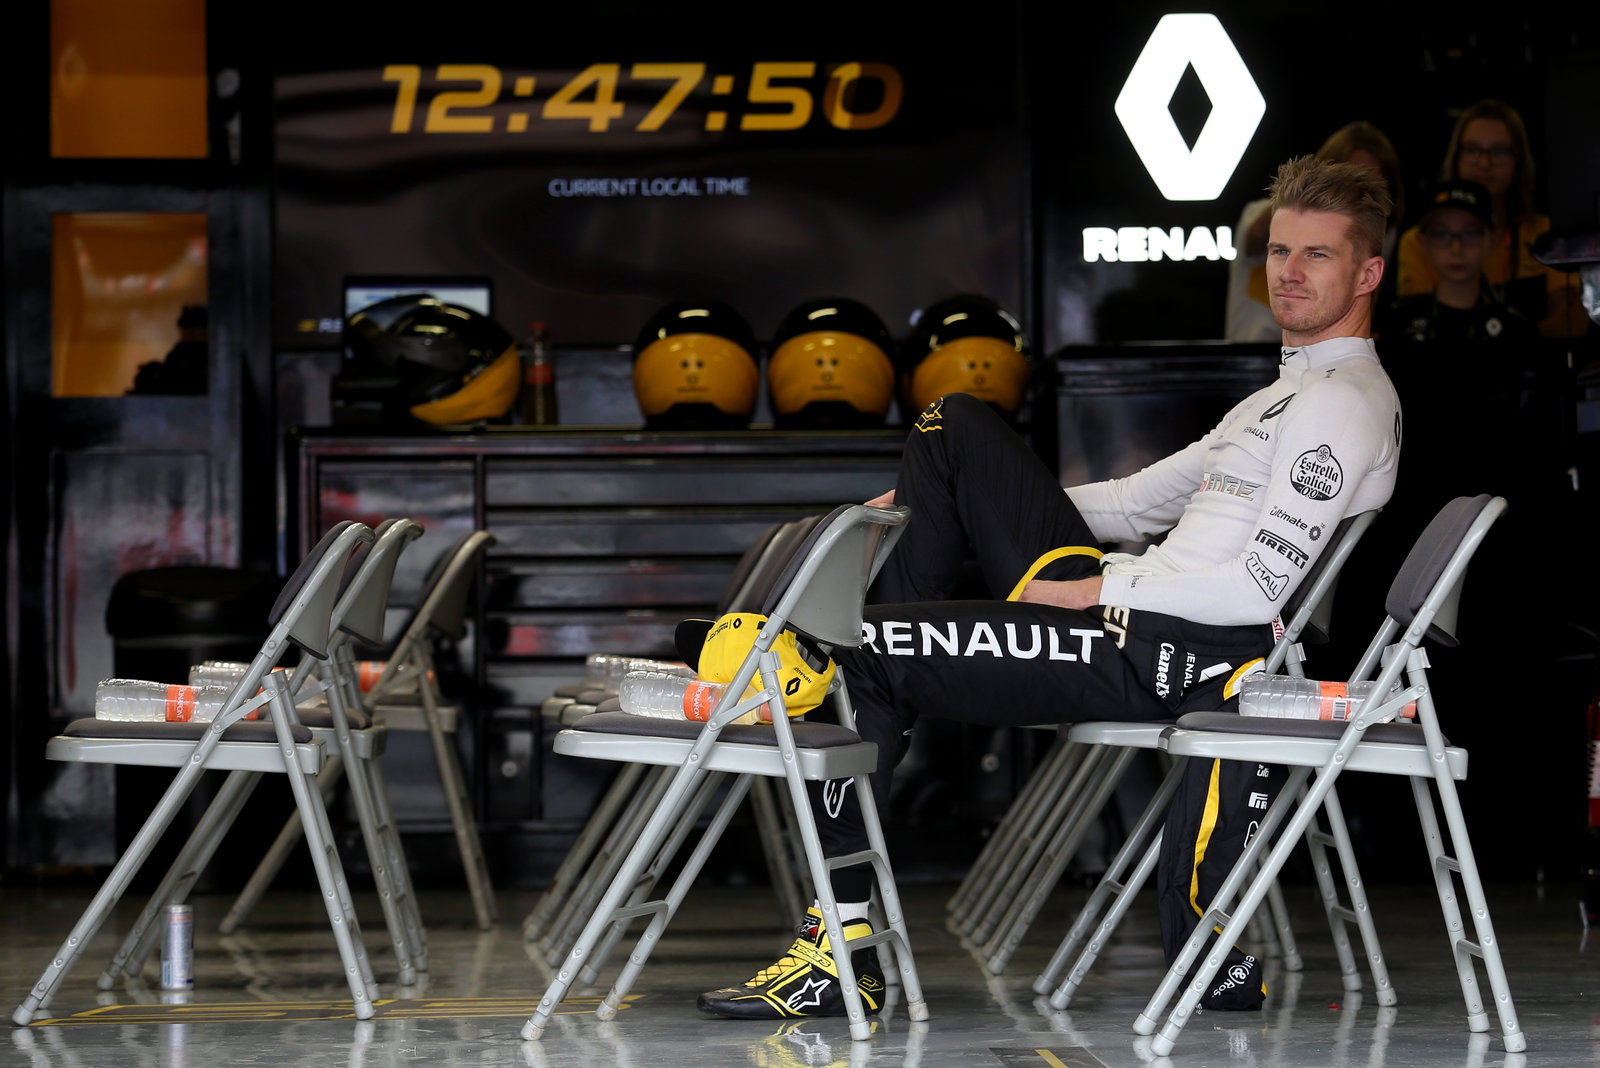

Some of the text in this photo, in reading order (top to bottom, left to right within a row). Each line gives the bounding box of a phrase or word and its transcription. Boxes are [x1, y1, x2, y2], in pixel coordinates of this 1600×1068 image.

[548, 176, 750, 198] CURRENT LOCAL TIME
[1297, 470, 1332, 495] Galicia
[1299, 457, 1339, 482] Estrella
[1269, 508, 1309, 531] ultimate
[1254, 528, 1310, 570] PIRELLI
[1251, 560, 1278, 596] TMALL
[1103, 605, 1130, 649] ED
[1272, 614, 1284, 641] astro
[861, 620, 1104, 665] RENAULT
[1156, 642, 1175, 699] Canel's
[1242, 955, 1255, 969] ell
[1211, 978, 1236, 998] Ros
